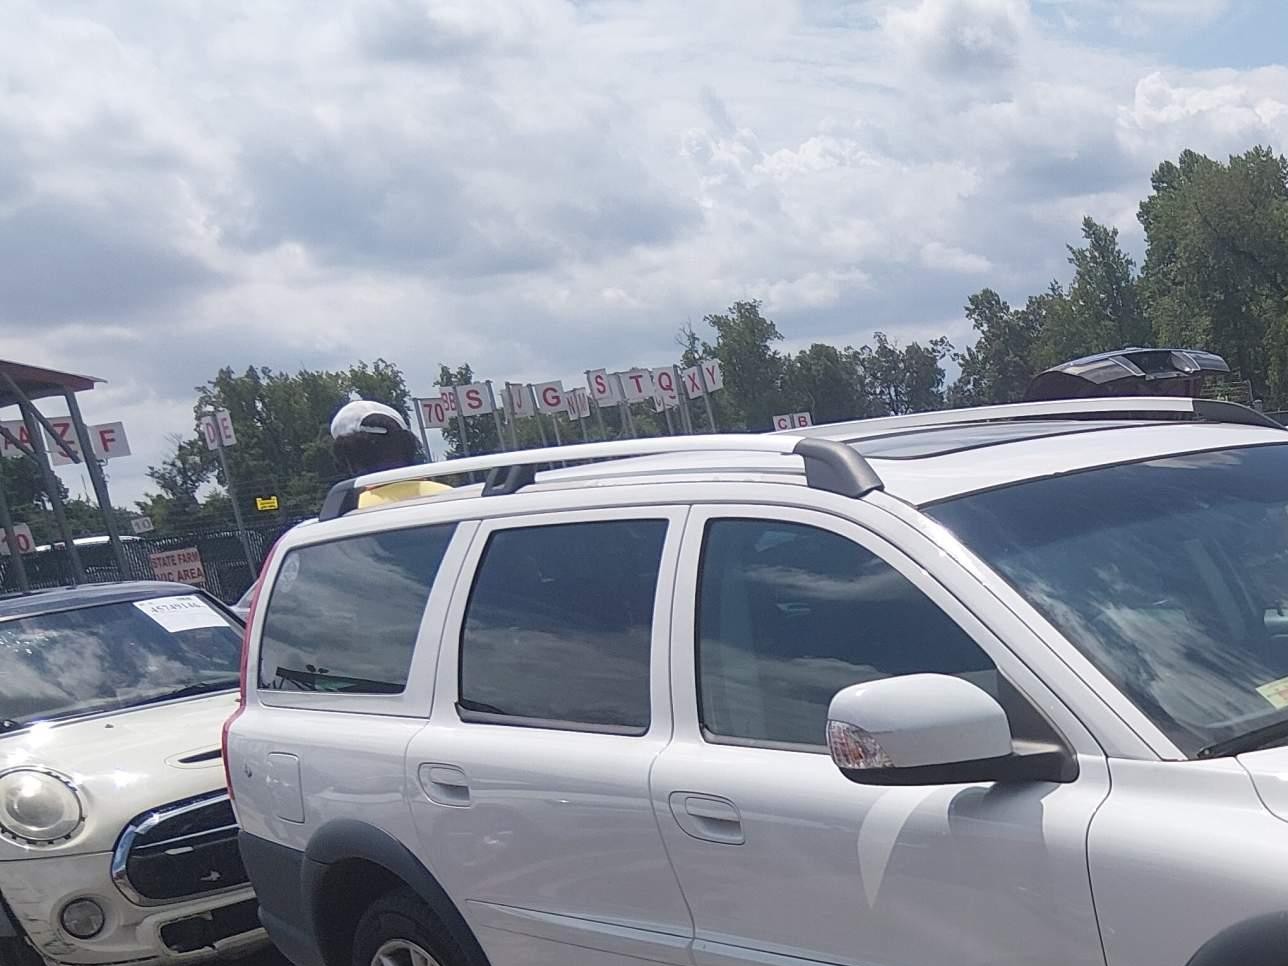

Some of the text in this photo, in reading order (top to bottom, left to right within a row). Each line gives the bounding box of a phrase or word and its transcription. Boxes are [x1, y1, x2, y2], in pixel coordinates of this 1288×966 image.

[595, 374, 606, 394] S
[629, 374, 643, 393] T
[658, 372, 674, 392] Q
[688, 372, 701, 393] X
[706, 365, 717, 385] Y
[466, 389, 483, 409] S
[543, 387, 561, 407] G
[423, 403, 445, 423] 70
[798, 415, 808, 427] B
[206, 422, 216, 444] D
[221, 417, 232, 439] E
[778, 418, 788, 430] C
[99, 429, 116, 452] F
[135, 518, 151, 530] 10
[151, 551, 198, 568] STATE FARM
[177, 567, 203, 582] AREA
